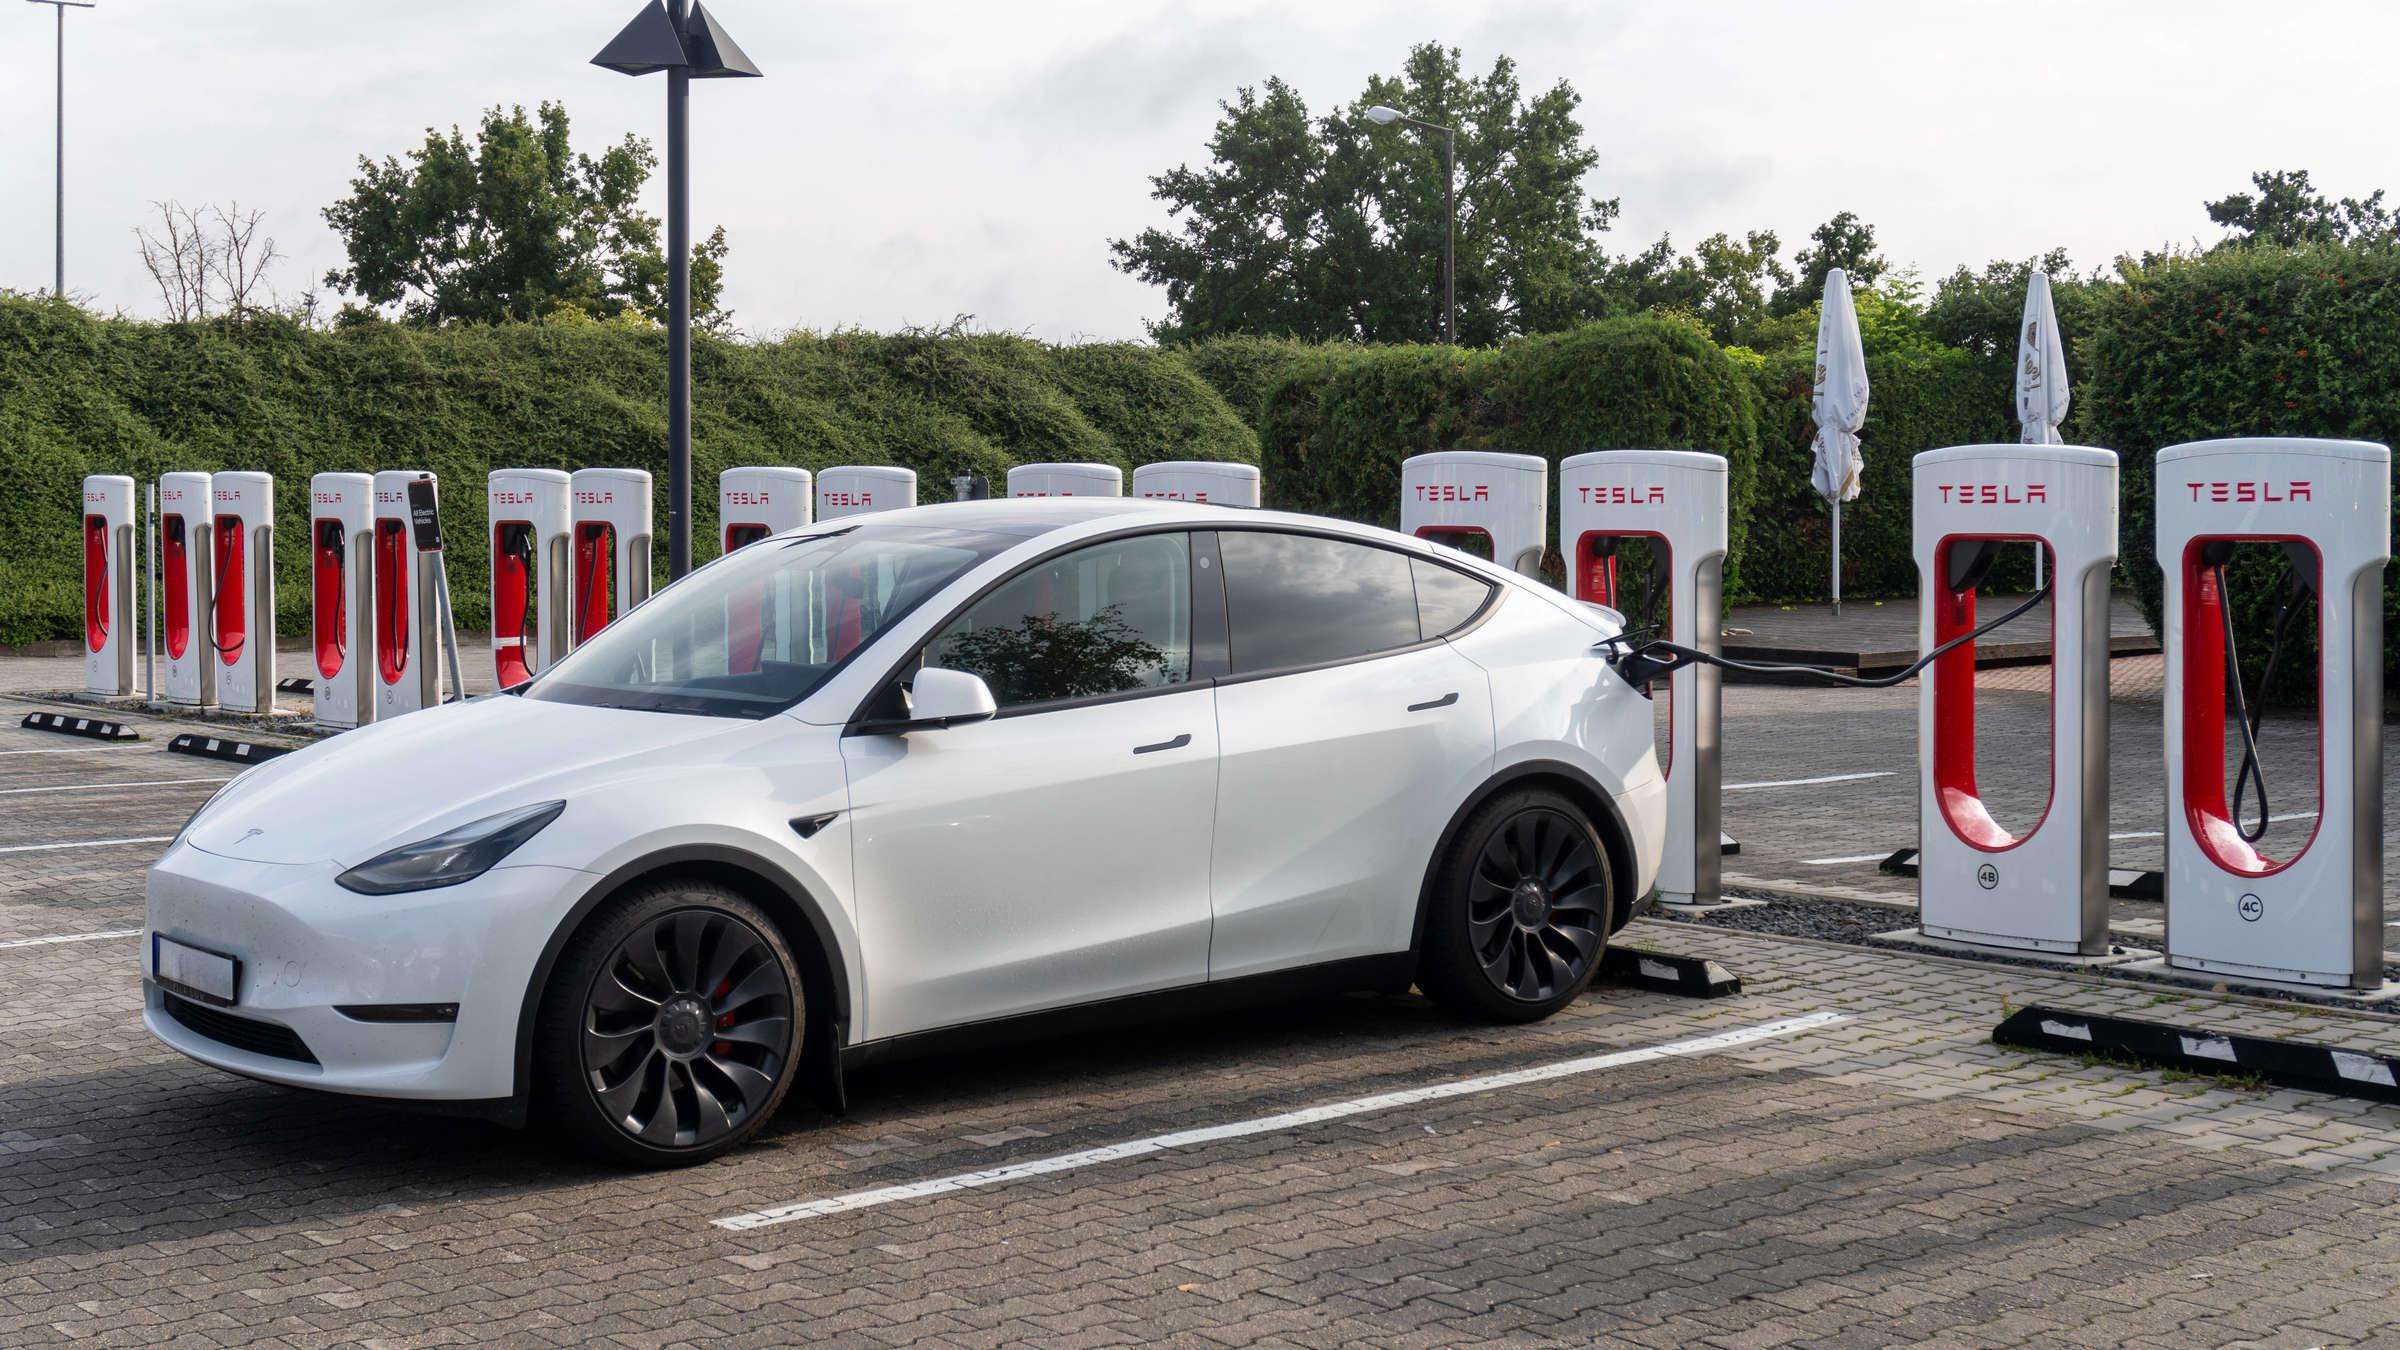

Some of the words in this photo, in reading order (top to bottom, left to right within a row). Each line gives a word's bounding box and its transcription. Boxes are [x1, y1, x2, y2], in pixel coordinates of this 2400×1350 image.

[214, 491, 240, 501] TESLA
[315, 492, 341, 503] TESLA
[376, 492, 402, 502] TESLA
[494, 492, 533, 504] TESLA
[576, 492, 612, 504] TESLA
[726, 491, 768, 505] TESLA
[1415, 485, 1489, 502] TESLA
[1579, 487, 1665, 505] TESLA
[1938, 484, 2047, 505] TESLA
[2187, 481, 2311, 503] TESLA
[824, 492, 871, 507] TESLA
[1981, 871, 1996, 882] 4B
[2242, 902, 2259, 913] 4C
